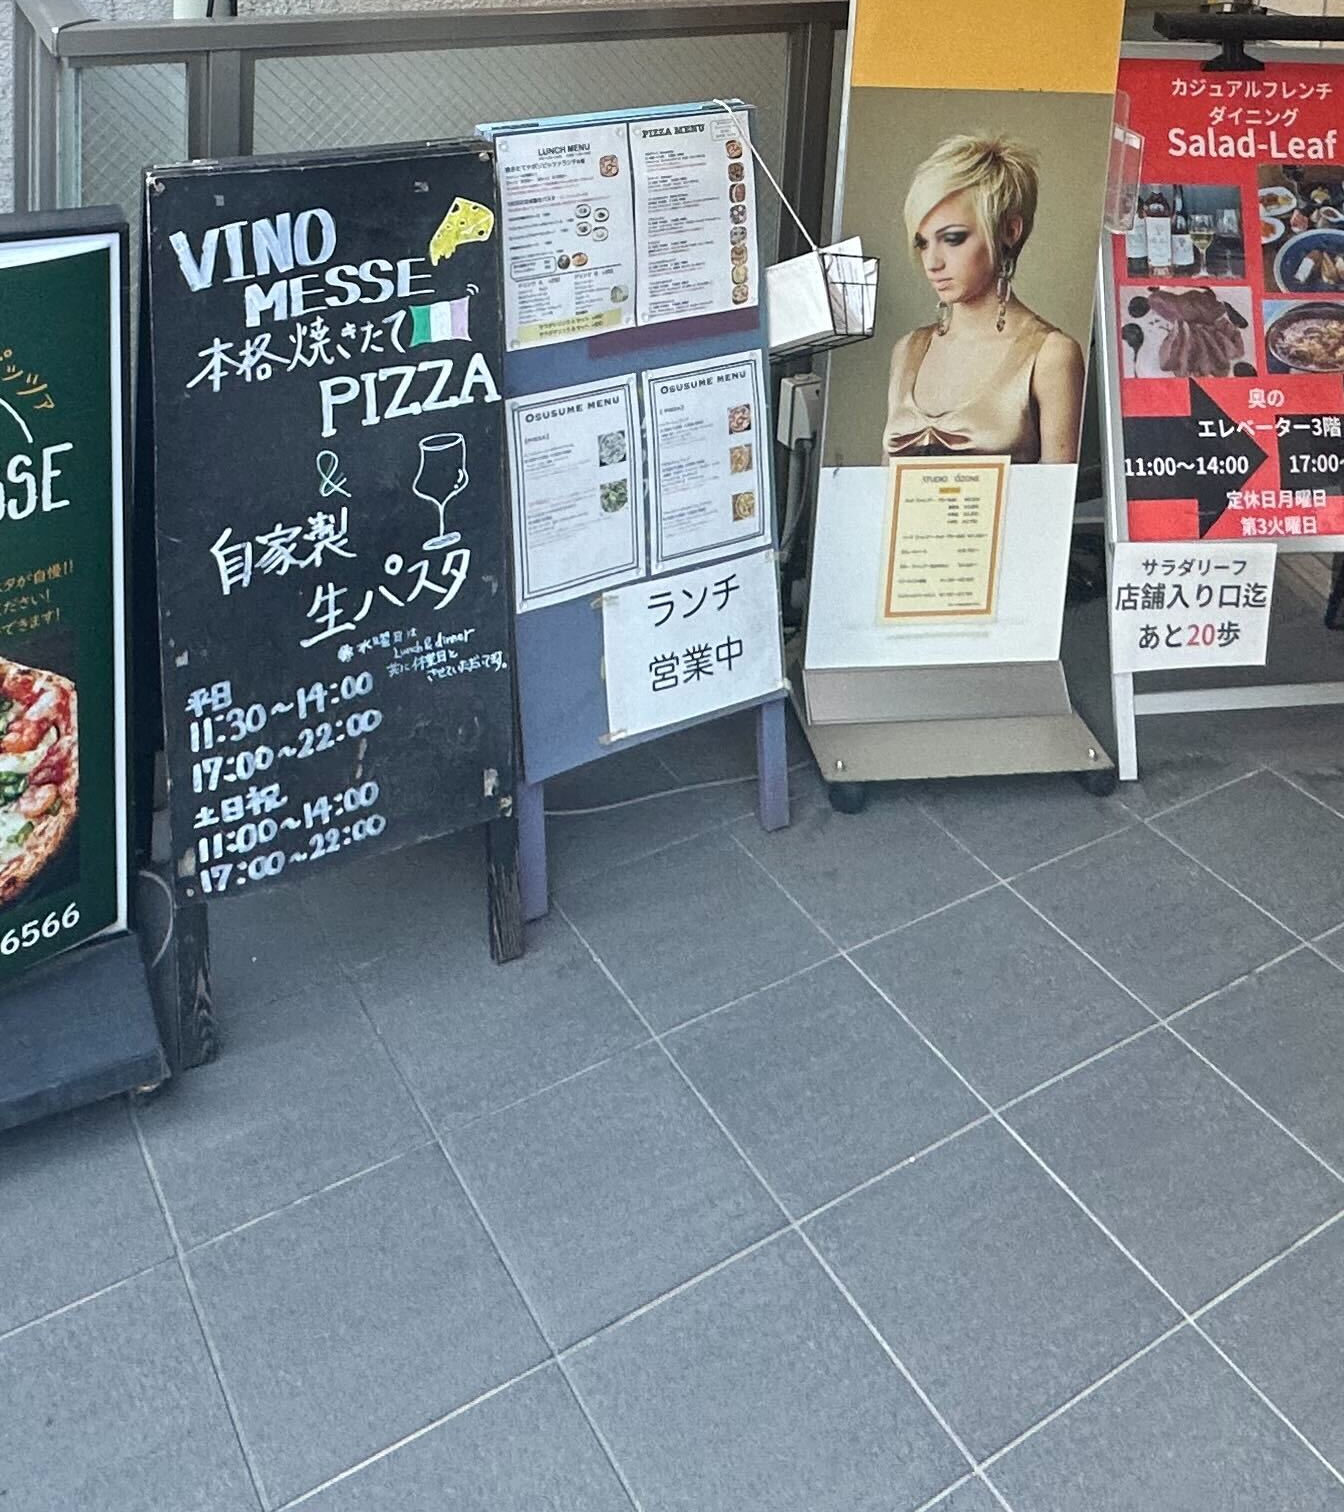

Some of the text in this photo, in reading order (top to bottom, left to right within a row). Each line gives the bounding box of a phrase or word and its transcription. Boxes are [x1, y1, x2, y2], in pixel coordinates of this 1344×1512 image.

[1171, 77, 1333, 101] カジュアルフレンチ
[642, 127, 672, 138] PIZZA
[674, 123, 705, 134] MENU
[1209, 107, 1300, 127] ダイニング
[538, 143, 591, 156] LUNCH MENU
[1168, 128, 1337, 161] Salad-Leaf
[169, 207, 336, 291] VINO
[245, 257, 435, 327] MESSE
[186, 310, 406, 392] 本格焼きたて
[319, 353, 501, 437] PIZZA
[1248, 388, 1285, 409] 奥の
[1198, 416, 1343, 438] エレベーター3階
[316, 450, 352, 497] &
[1226, 489, 1327, 508] 定休日月曜日
[1241, 516, 1318, 536] 第3火曜日
[210, 506, 357, 595] 自家製
[1142, 558, 1247, 577] サラダリーフ
[300, 548, 471, 647] 生パスタ
[647, 573, 740, 627] ランチ
[1115, 583, 1268, 612] 店舗入り口迄
[1138, 622, 1241, 649] あと20歩
[649, 635, 743, 691] 営業中
[185, 680, 233, 717] 平日
[194, 783, 288, 829] 土日祝
